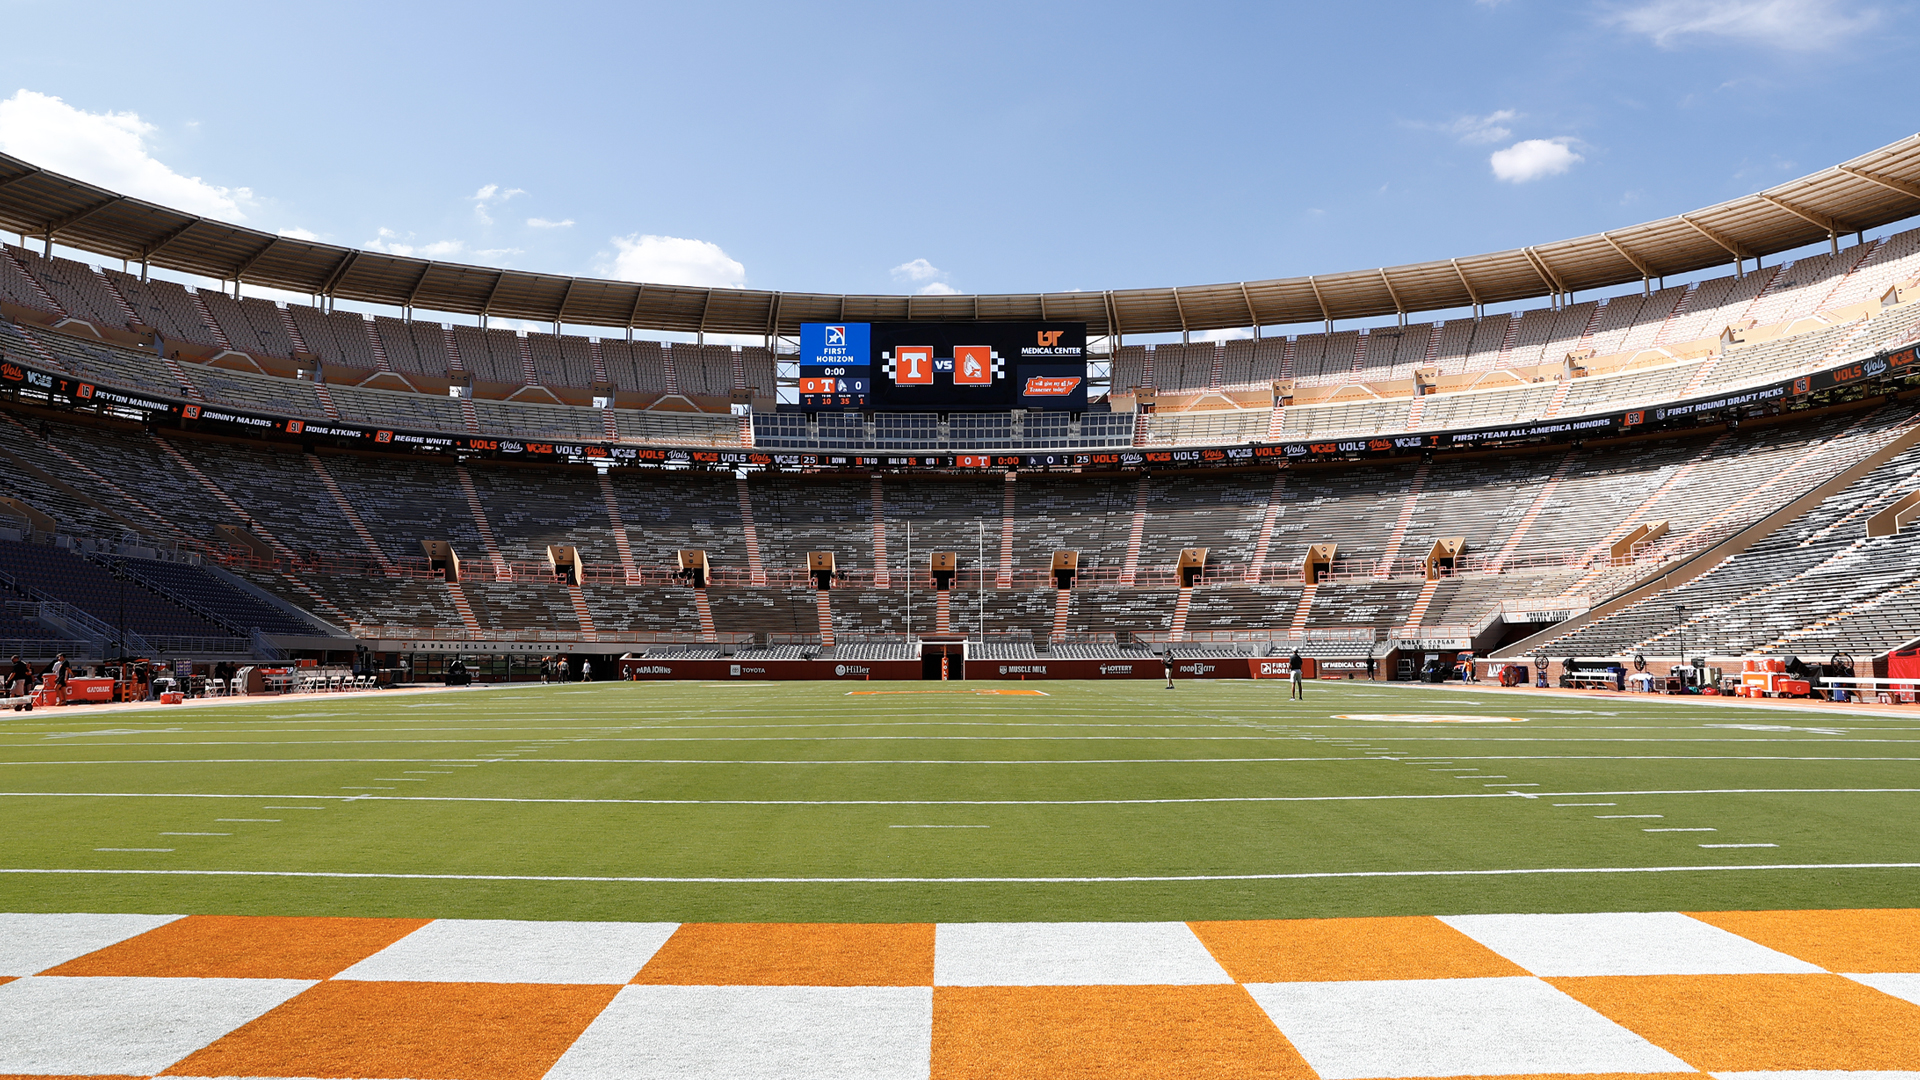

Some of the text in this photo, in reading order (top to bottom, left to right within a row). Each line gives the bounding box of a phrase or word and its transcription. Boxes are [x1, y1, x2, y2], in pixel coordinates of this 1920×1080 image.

[1038, 330, 1064, 346] UT
[902, 352, 927, 378] T
[934, 360, 953, 370] VS
[0, 363, 24, 381] Vols
[60, 380, 68, 392] T
[824, 368, 846, 376] 0:00
[1796, 379, 1807, 392] 46
[1833, 365, 1862, 382] VOLS
[1864, 358, 1886, 376] Vols
[807, 379, 862, 392] 0 T 0
[82, 384, 169, 412] 16 PEYTON MANNING
[1628, 412, 1640, 424] 93
[1667, 406, 1694, 416] FIRST
[1694, 399, 1726, 412] ROUND
[1727, 394, 1758, 406] DRAFT
[1758, 387, 1784, 400] PICKS
[186, 406, 272, 428] 45 JOHNNY MAJORS
[290, 422, 362, 438] 91 DOUG ATKINS
[1452, 418, 1610, 442] FIRST-TEAM ALL-AMERICA HONORS
[378, 432, 452, 446] 92 REGGIE WHITE
[470, 439, 498, 450] VOLS
[500, 440, 524, 452] Vols
[556, 445, 582, 454] VOLS
[584, 446, 608, 457] Vols
[638, 450, 665, 459] VOLS
[668, 450, 690, 461] Vols
[721, 454, 746, 462] VOLS
[748, 453, 772, 464] Vols
[1092, 454, 1118, 464] VOLS
[1120, 452, 1143, 464] Vols
[1174, 451, 1200, 460] VOLS
[1202, 450, 1225, 460] Vols
[1256, 446, 1282, 456] VOLS
[1284, 444, 1307, 456] Vols
[1338, 442, 1366, 452] VOLS
[1368, 438, 1392, 451] Vols
[1430, 436, 1439, 444] T
[803, 456, 816, 464] 25
[856, 457, 862, 465] 10
[908, 458, 916, 466] 35
[964, 456, 988, 466] 0 T
[998, 456, 1020, 464] 0:00
[1046, 456, 1054, 464] 0
[1076, 456, 1089, 464] 25
[636, 665, 671, 674] PAPA JOHNS
[846, 666, 870, 674] Hiller
[1032, 666, 1047, 674] MILK
[66, 686, 72, 694] G
